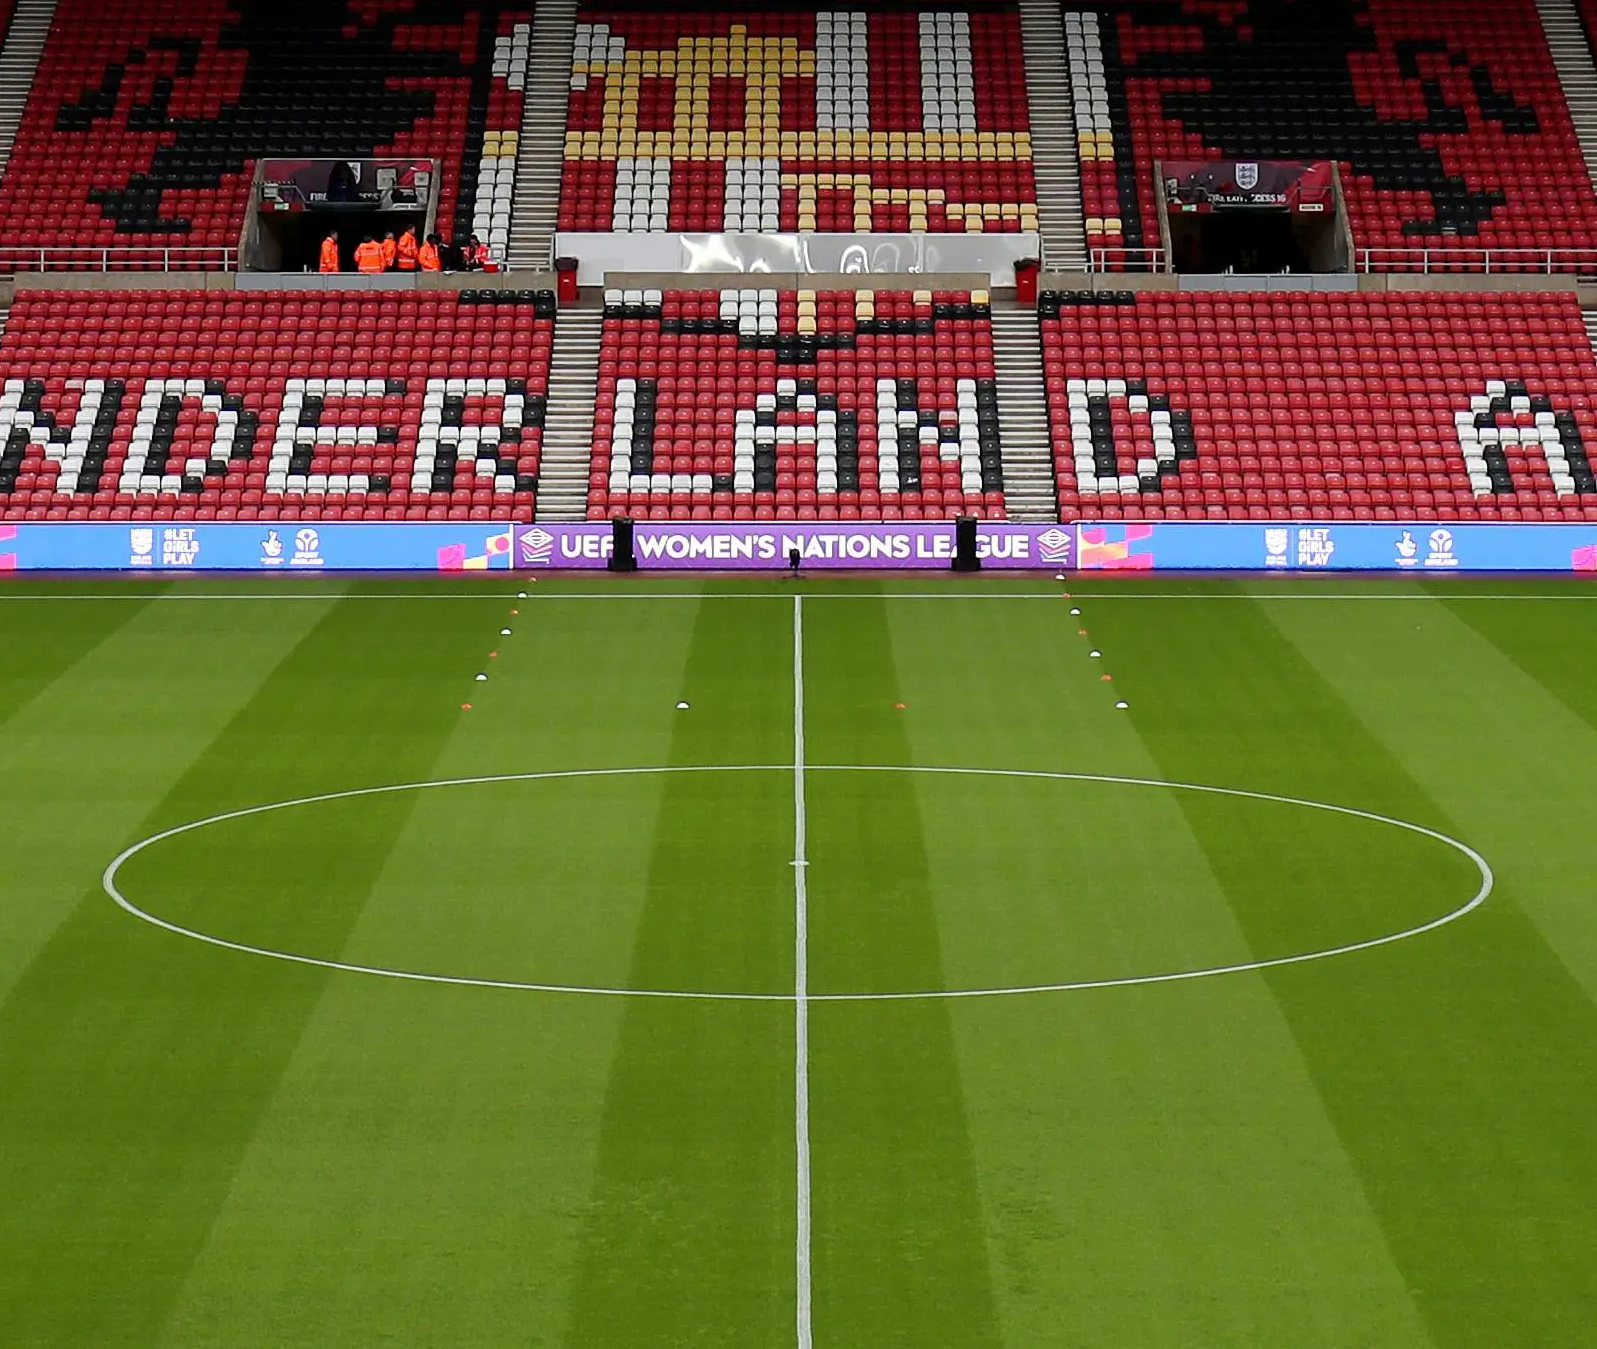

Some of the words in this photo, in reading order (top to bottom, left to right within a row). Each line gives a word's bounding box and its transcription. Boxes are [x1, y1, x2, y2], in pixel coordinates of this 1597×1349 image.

[561, 534, 614, 559] UEF
[637, 534, 776, 559] WOMEN'S
[782, 534, 911, 559] NATIONS
[916, 534, 1029, 559] LEGUE
[163, 553, 195, 564] PLAY
[1298, 553, 1330, 565] PLAY
